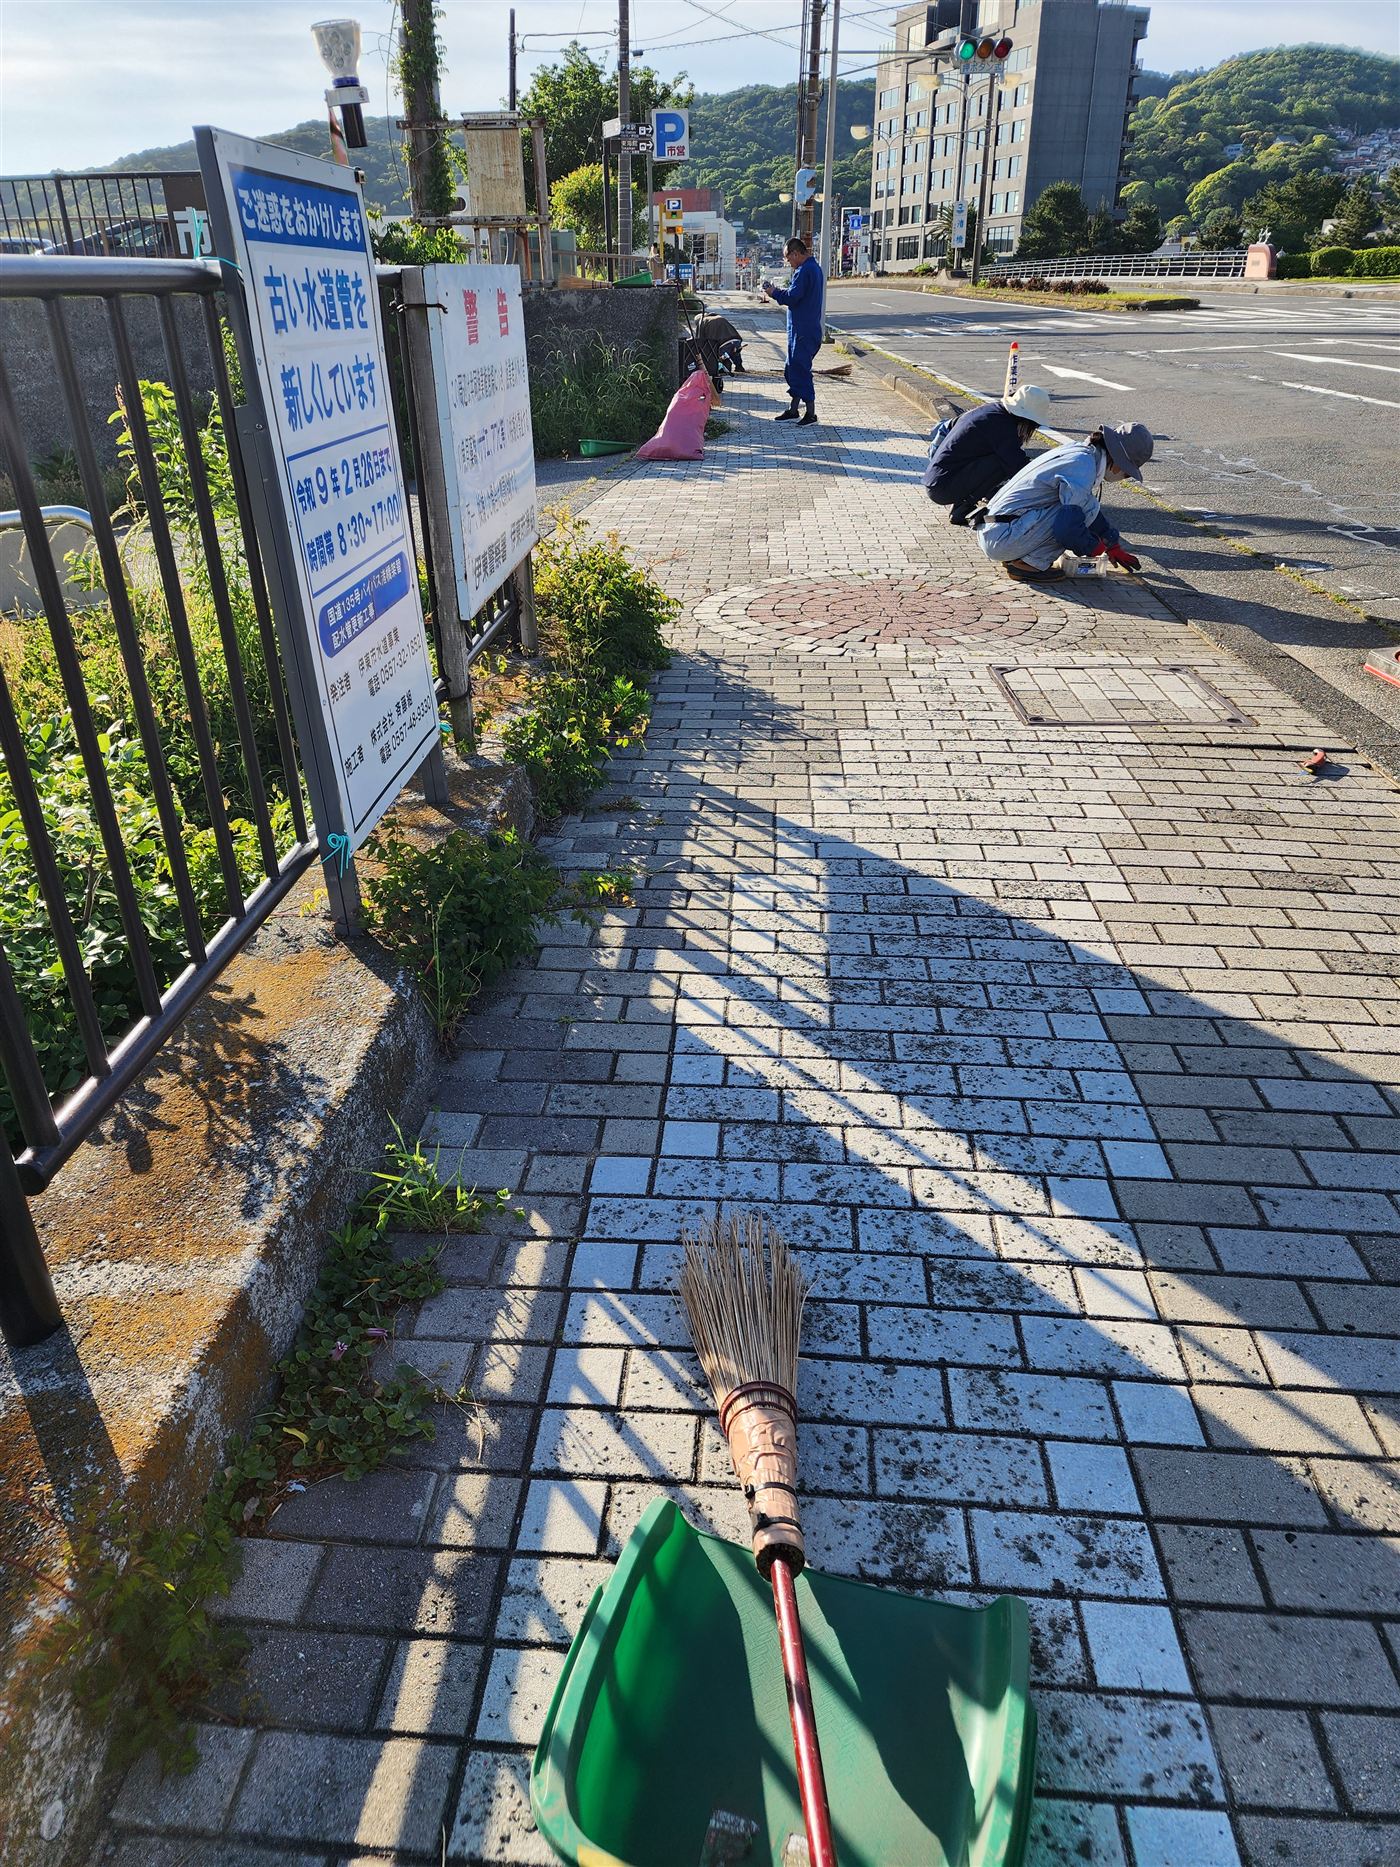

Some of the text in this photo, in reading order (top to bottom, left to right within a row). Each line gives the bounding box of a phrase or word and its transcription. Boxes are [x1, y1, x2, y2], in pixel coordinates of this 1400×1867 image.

[656, 113, 685, 157] P
[667, 146, 686, 156] 市営
[238, 188, 361, 243] ご迷惑をおかけします
[668, 200, 681, 211] P
[173, 206, 212, 255] 市
[263, 265, 369, 335] 古い水道管を
[280, 352, 376, 432] 新しくしています
[306, 529, 335, 574] 時間帯
[331, 602, 376, 650] 配水管更新工事
[328, 626, 400, 704] 発注者 伊東市水道事業
[367, 671, 381, 697] 電話
[344, 744, 365, 779] 施工者
[370, 708, 395, 747] 株式会社
[379, 740, 392, 765] 電話
